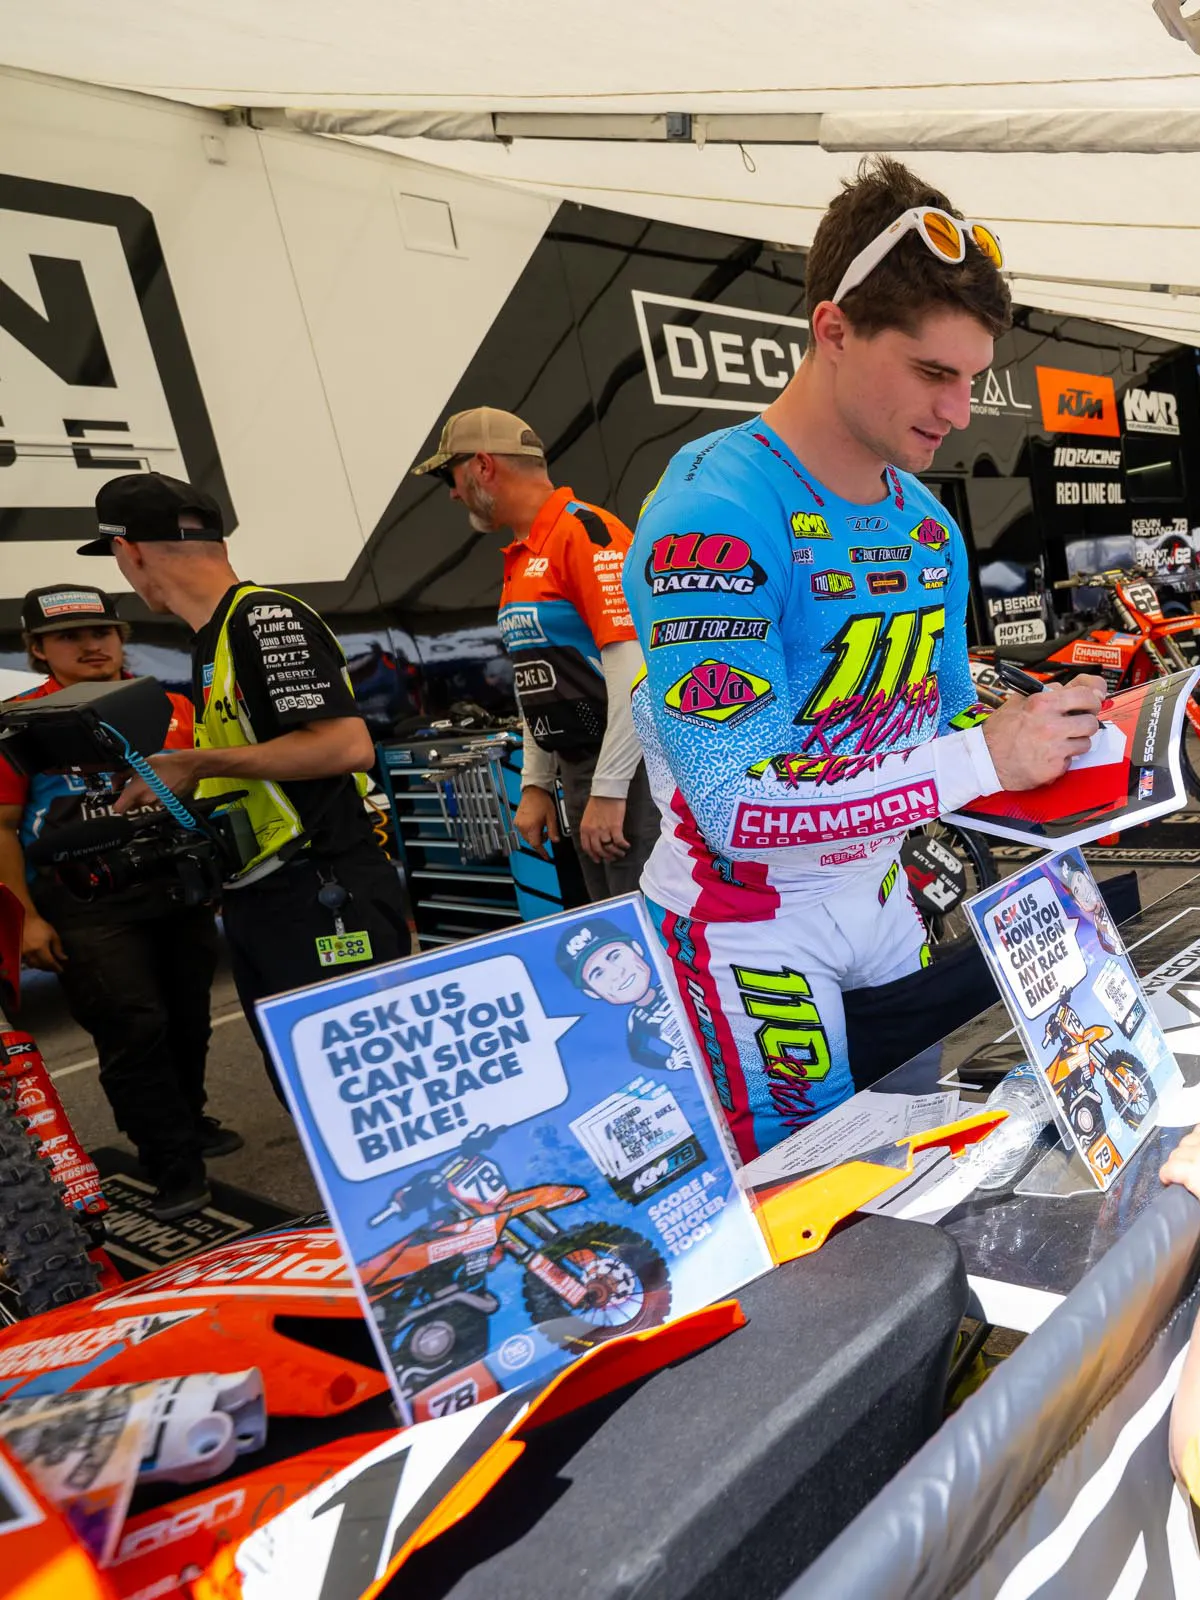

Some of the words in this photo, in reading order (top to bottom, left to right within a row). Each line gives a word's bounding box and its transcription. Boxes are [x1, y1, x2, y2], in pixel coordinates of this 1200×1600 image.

[663, 323, 803, 388] DEC
[1057, 388, 1104, 421] KTM
[1123, 388, 1179, 426] KMR
[1056, 482, 1080, 505] RED
[1081, 482, 1107, 504] LINE
[1131, 519, 1162, 528] KEVIN
[1132, 526, 1173, 537] MORANZ
[1172, 518, 1188, 534] 78
[651, 533, 752, 573] 110
[1174, 548, 1192, 564] 62
[652, 574, 755, 595] RACING
[814, 576, 828, 592] 110
[828, 572, 853, 593] RACING
[248, 605, 293, 626] KTM
[1005, 595, 1042, 610] BERRY
[264, 622, 285, 633] LINE
[287, 621, 304, 631] OIL
[281, 634, 306, 644] FORCE
[664, 620, 698, 642] BUILT
[699, 620, 730, 639] FOR
[731, 621, 767, 639] ELITE
[1000, 624, 1034, 636] HOYT'S
[1000, 636, 1019, 645] Truck
[1020, 632, 1045, 642] Center
[1075, 647, 1119, 660] CHAMPION
[277, 669, 316, 680] BERRY
[286, 684, 310, 692] ELLIS
[312, 681, 331, 690] LAW
[275, 693, 325, 713] geebo
[664, 706, 717, 731] PREMIUM
[1143, 695, 1164, 763] SUPERCROSS
[741, 786, 935, 834] CHAMPION
[739, 834, 806, 845] TOOL
[821, 807, 936, 840] STORAGE
[993, 905, 1019, 934] ASK
[1019, 893, 1038, 917] US
[1003, 921, 1034, 952] HOW
[1033, 902, 1060, 930] YOU
[1010, 940, 1040, 972] CAN
[1038, 920, 1066, 952] SIGN
[1018, 963, 1039, 990] MY
[1040, 941, 1069, 977] RACE
[1025, 973, 1058, 1009] BIKE!
[321, 1000, 407, 1050] ASK
[410, 982, 467, 1017] US
[327, 1019, 434, 1078] HOW
[440, 992, 525, 1037] YOU
[339, 1056, 427, 1104] CAN
[433, 1019, 531, 1073] SIGN
[350, 1087, 414, 1136] MY
[423, 1051, 523, 1101] RACE
[612, 1118, 636, 1135] KEVIN
[613, 1105, 641, 1126] SIGNED
[355, 1102, 469, 1164] BIKE!
[621, 1135, 637, 1149] AND
[646, 1127, 664, 1143] WAS
[626, 1149, 645, 1163] THIS
[1094, 1142, 1112, 1169] 78
[463, 1162, 500, 1200] 78
[648, 1178, 700, 1219] SCORE
[702, 1171, 716, 1187] A
[654, 1190, 708, 1233] SWEET
[662, 1195, 728, 1245] STICKER
[669, 1222, 713, 1256] TOO!
[431, 1381, 476, 1415] 78
